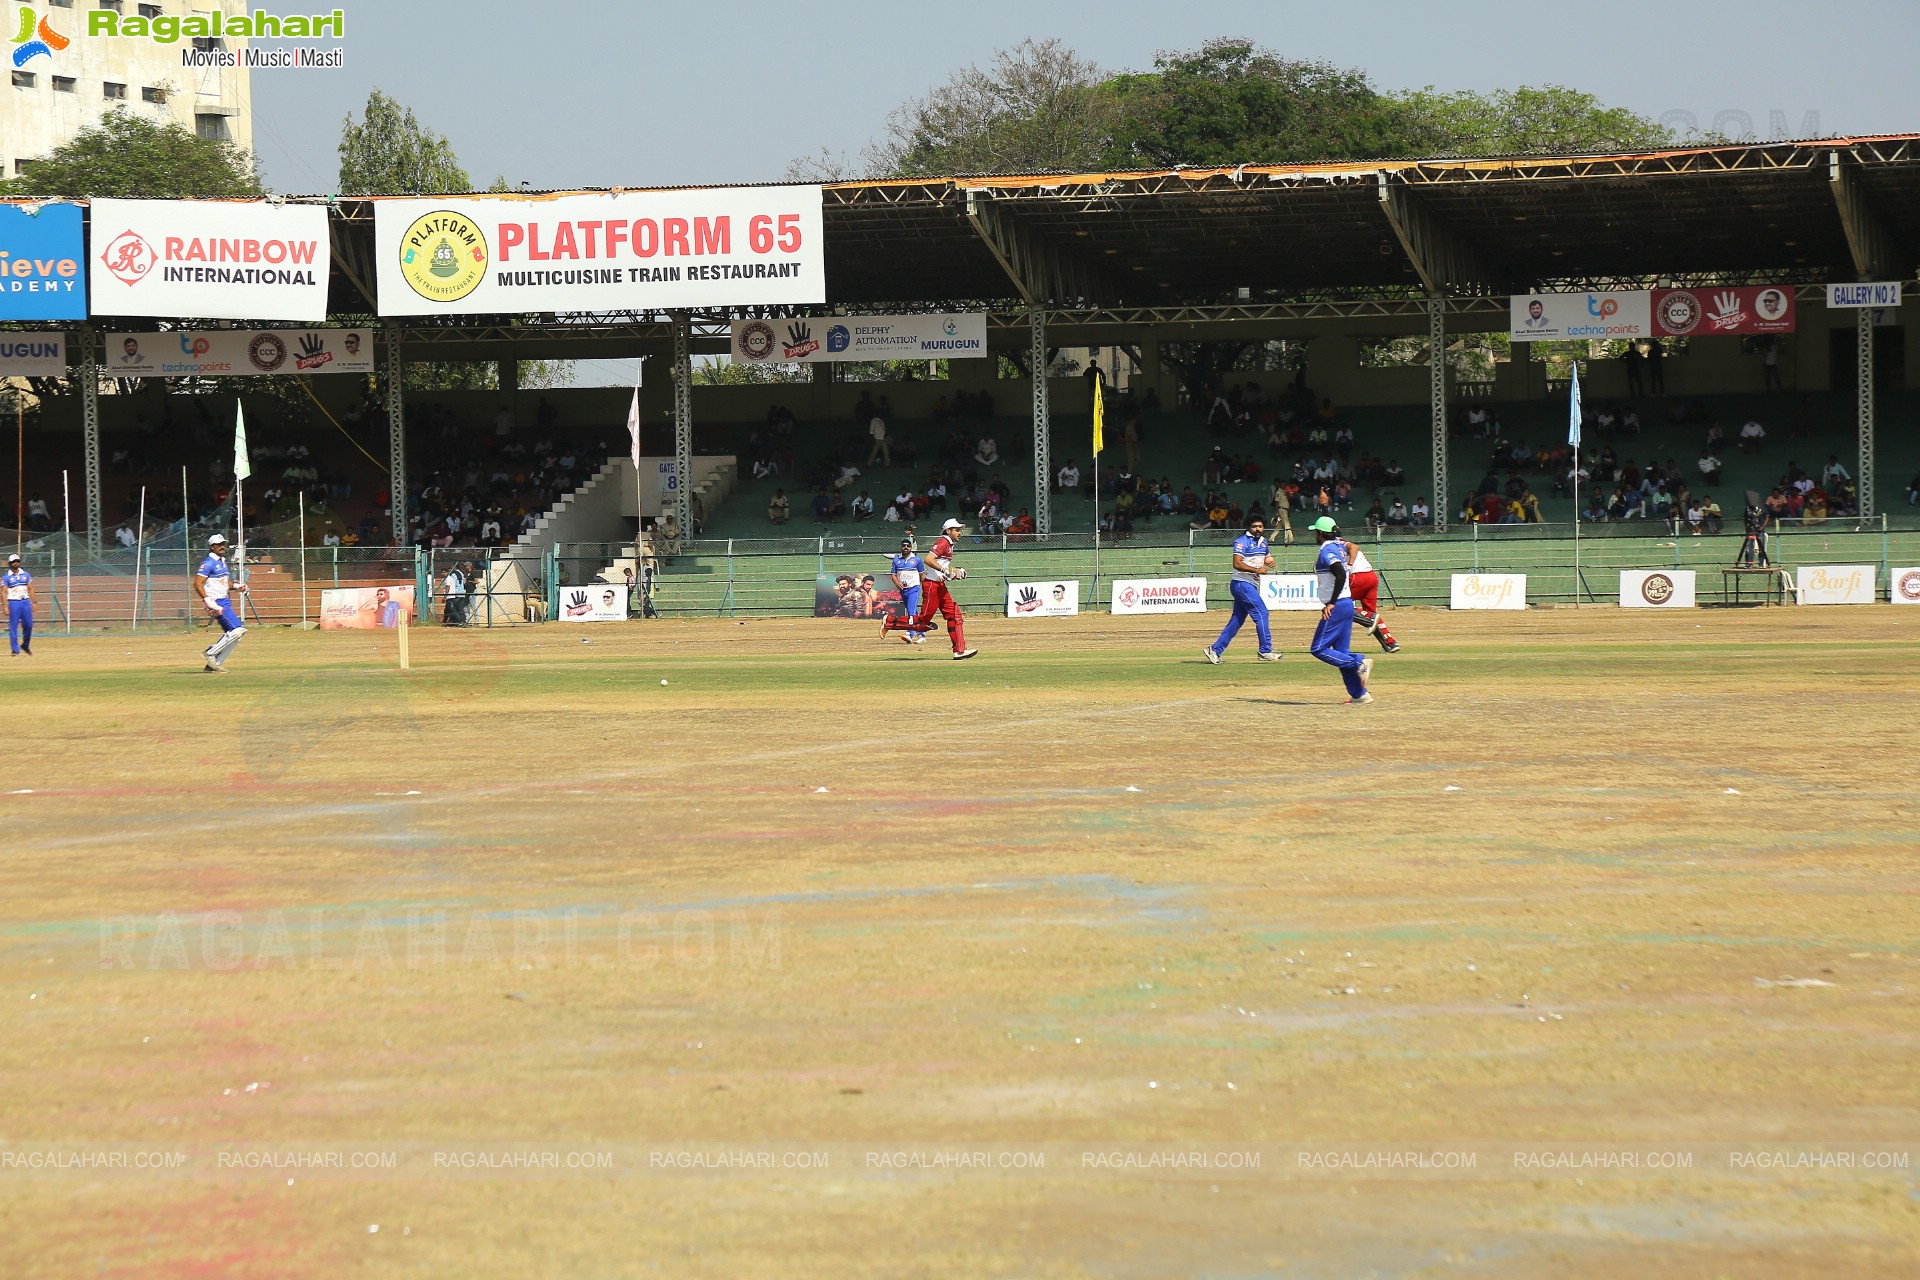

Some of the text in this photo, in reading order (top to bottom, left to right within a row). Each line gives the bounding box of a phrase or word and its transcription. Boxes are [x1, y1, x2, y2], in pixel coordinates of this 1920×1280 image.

[410, 218, 477, 247] PLATFORM
[498, 213, 802, 262] PLATFORM 65
[165, 236, 318, 265] RAINBOW
[437, 248, 451, 260] 65
[0, 251, 77, 277] ieve
[163, 267, 316, 286] INTERNATIONAL
[498, 262, 801, 287] MULTICUISINE TRAIN RESTAURANT
[1834, 285, 1896, 305] GALLERY NO 2
[1670, 309, 1688, 317] CCC
[1714, 312, 1746, 330] DRUGS
[855, 326, 890, 335] DELPHY
[1568, 323, 1640, 337] technopaints
[749, 337, 765, 345] CCC
[855, 336, 917, 345] AUTOMATION
[921, 339, 979, 350] MURUGUN
[1, 343, 58, 358] UGUN
[260, 348, 276, 356] CCC
[788, 341, 817, 357] DRUGS
[162, 361, 231, 373] technopaints
[300, 353, 331, 368] DRUGS
[660, 463, 675, 473] GATE
[668, 475, 677, 490] 8
[1142, 586, 1200, 597] RAINBOW
[1268, 580, 1304, 599] Srini
[1463, 575, 1514, 608] Barfi
[1810, 568, 1862, 601] Barfi
[1141, 597, 1200, 605] INTERNATIONAL
